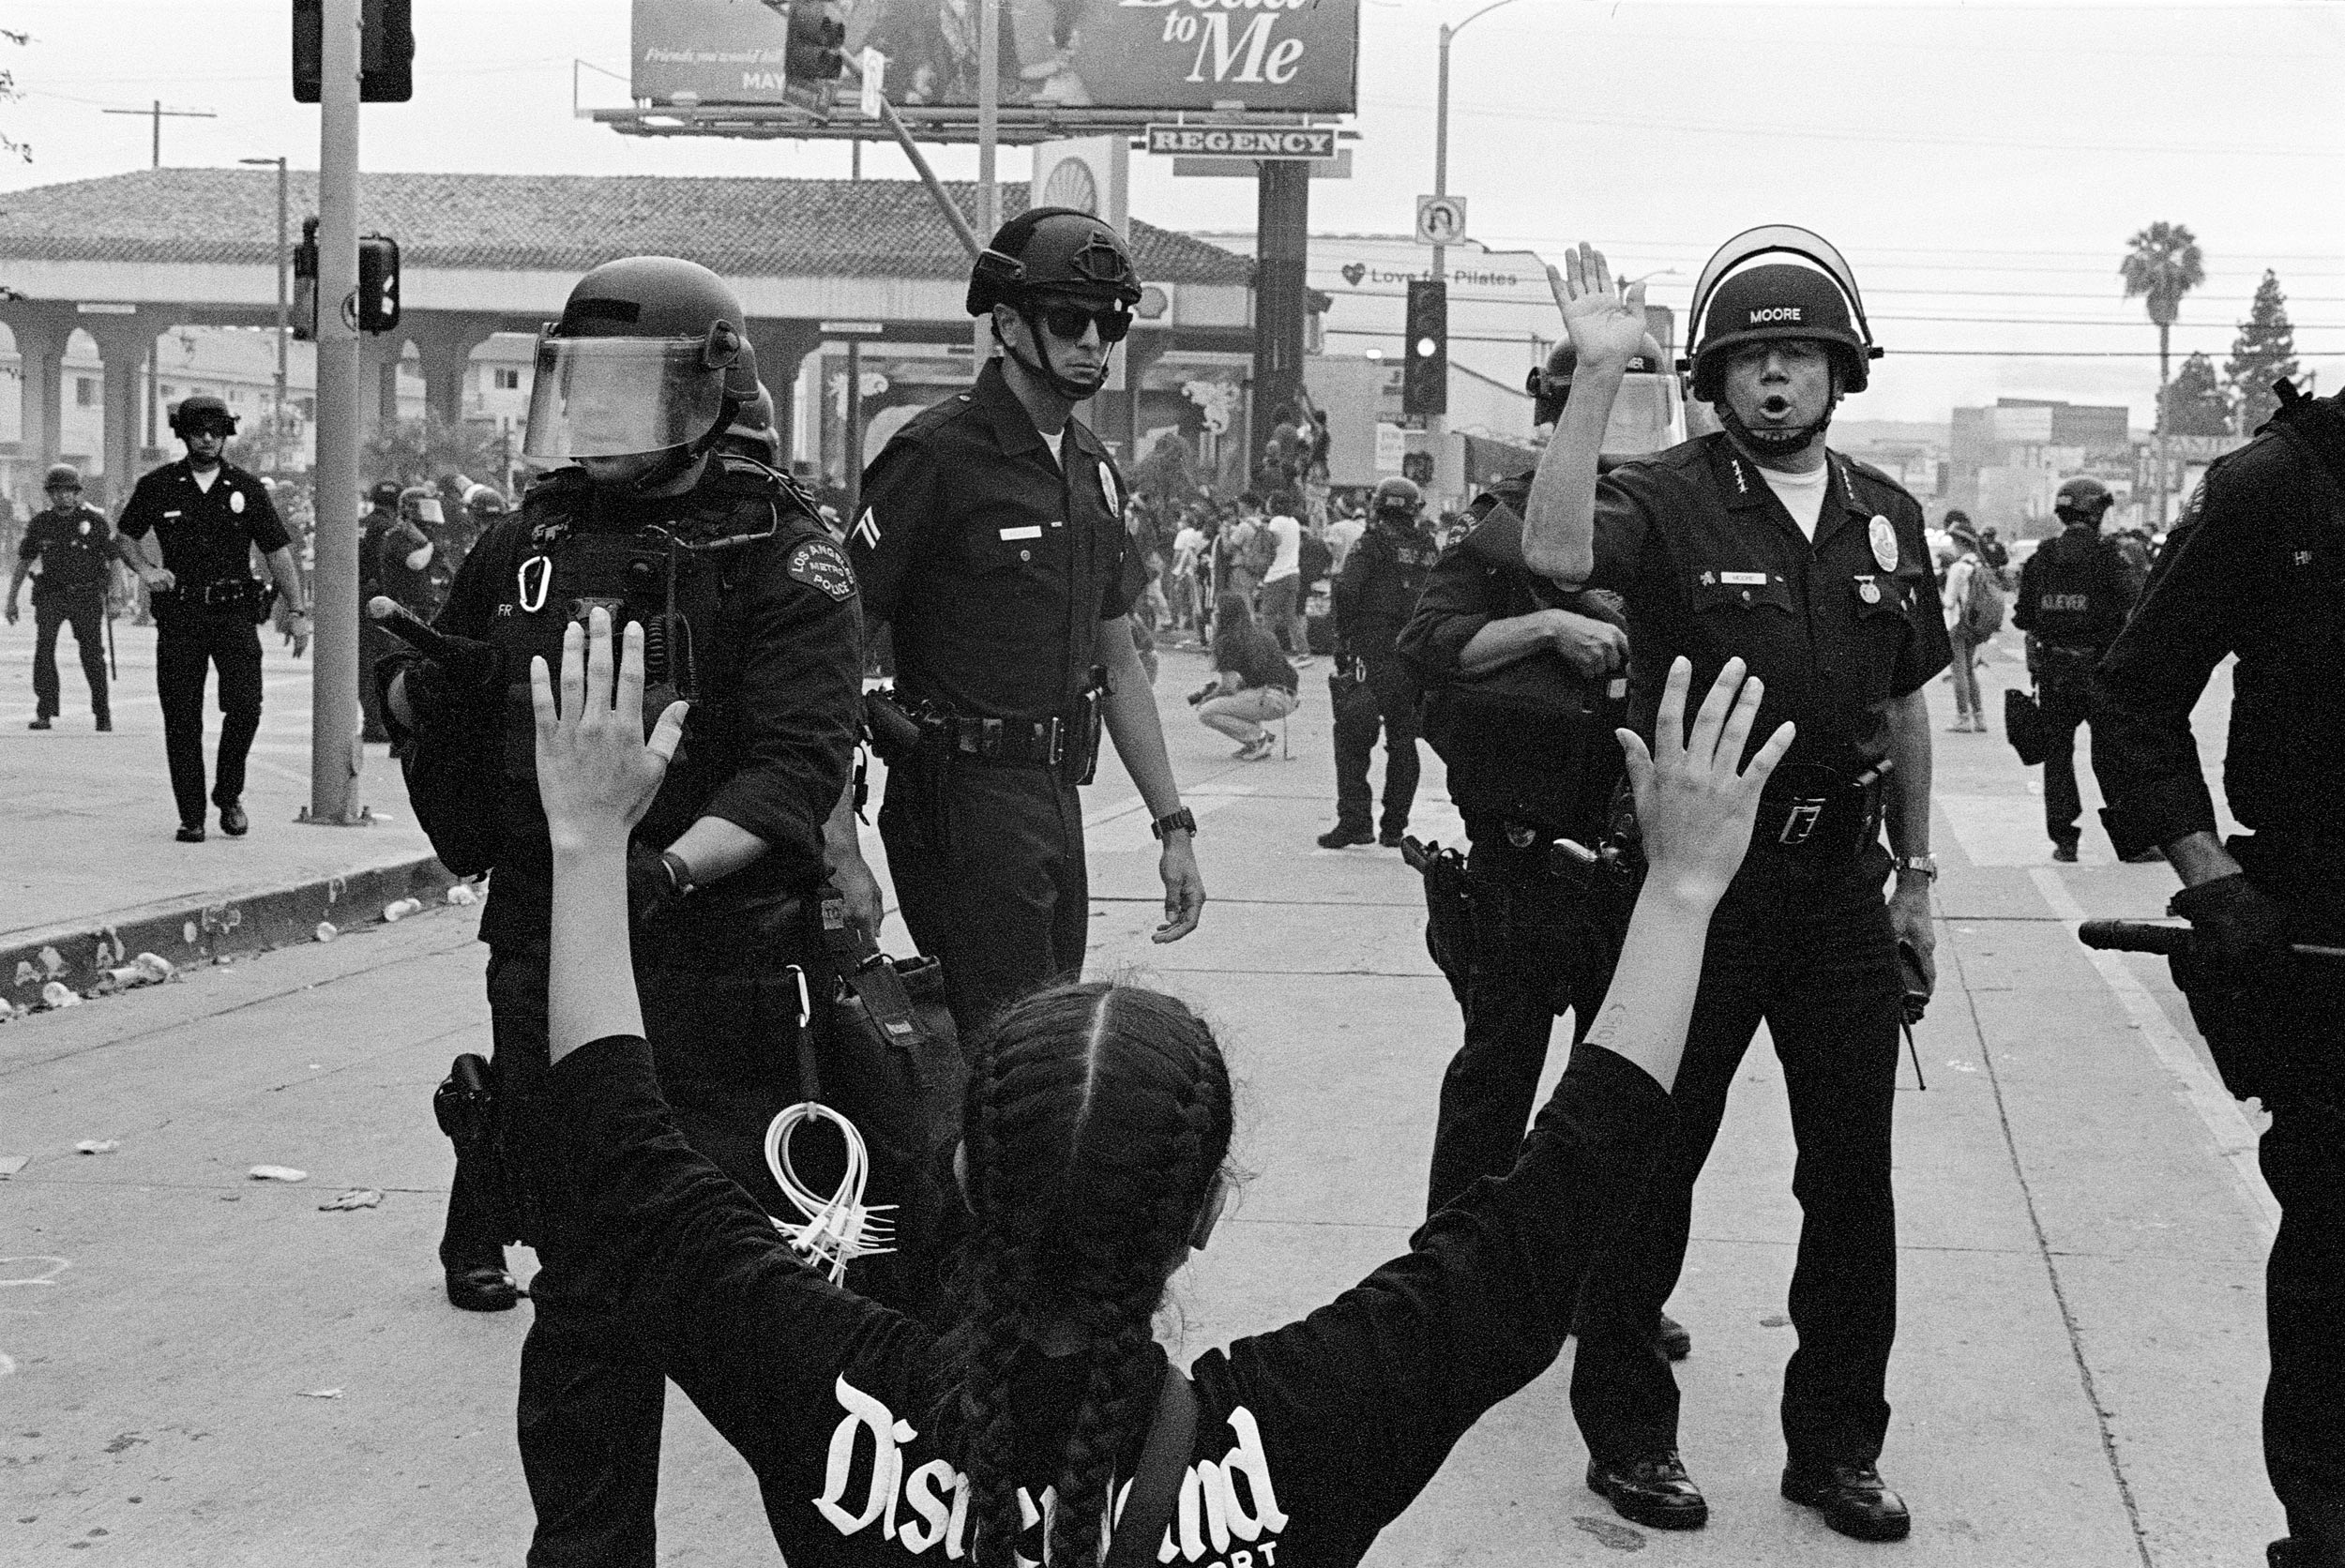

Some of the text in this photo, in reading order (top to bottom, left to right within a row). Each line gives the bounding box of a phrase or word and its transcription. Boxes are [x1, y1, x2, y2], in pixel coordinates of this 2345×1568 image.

[1162, 8, 1304, 84] to Me
[743, 71, 785, 90] MAY
[1152, 130, 1332, 153] REGENCY
[1455, 269, 1517, 285] Pilates
[1750, 308, 1801, 323] MOORE
[791, 544, 855, 584] LOS ANGELES
[809, 562, 845, 577] METRO
[813, 574, 850, 595] POLICE
[498, 604, 513, 617] FR
